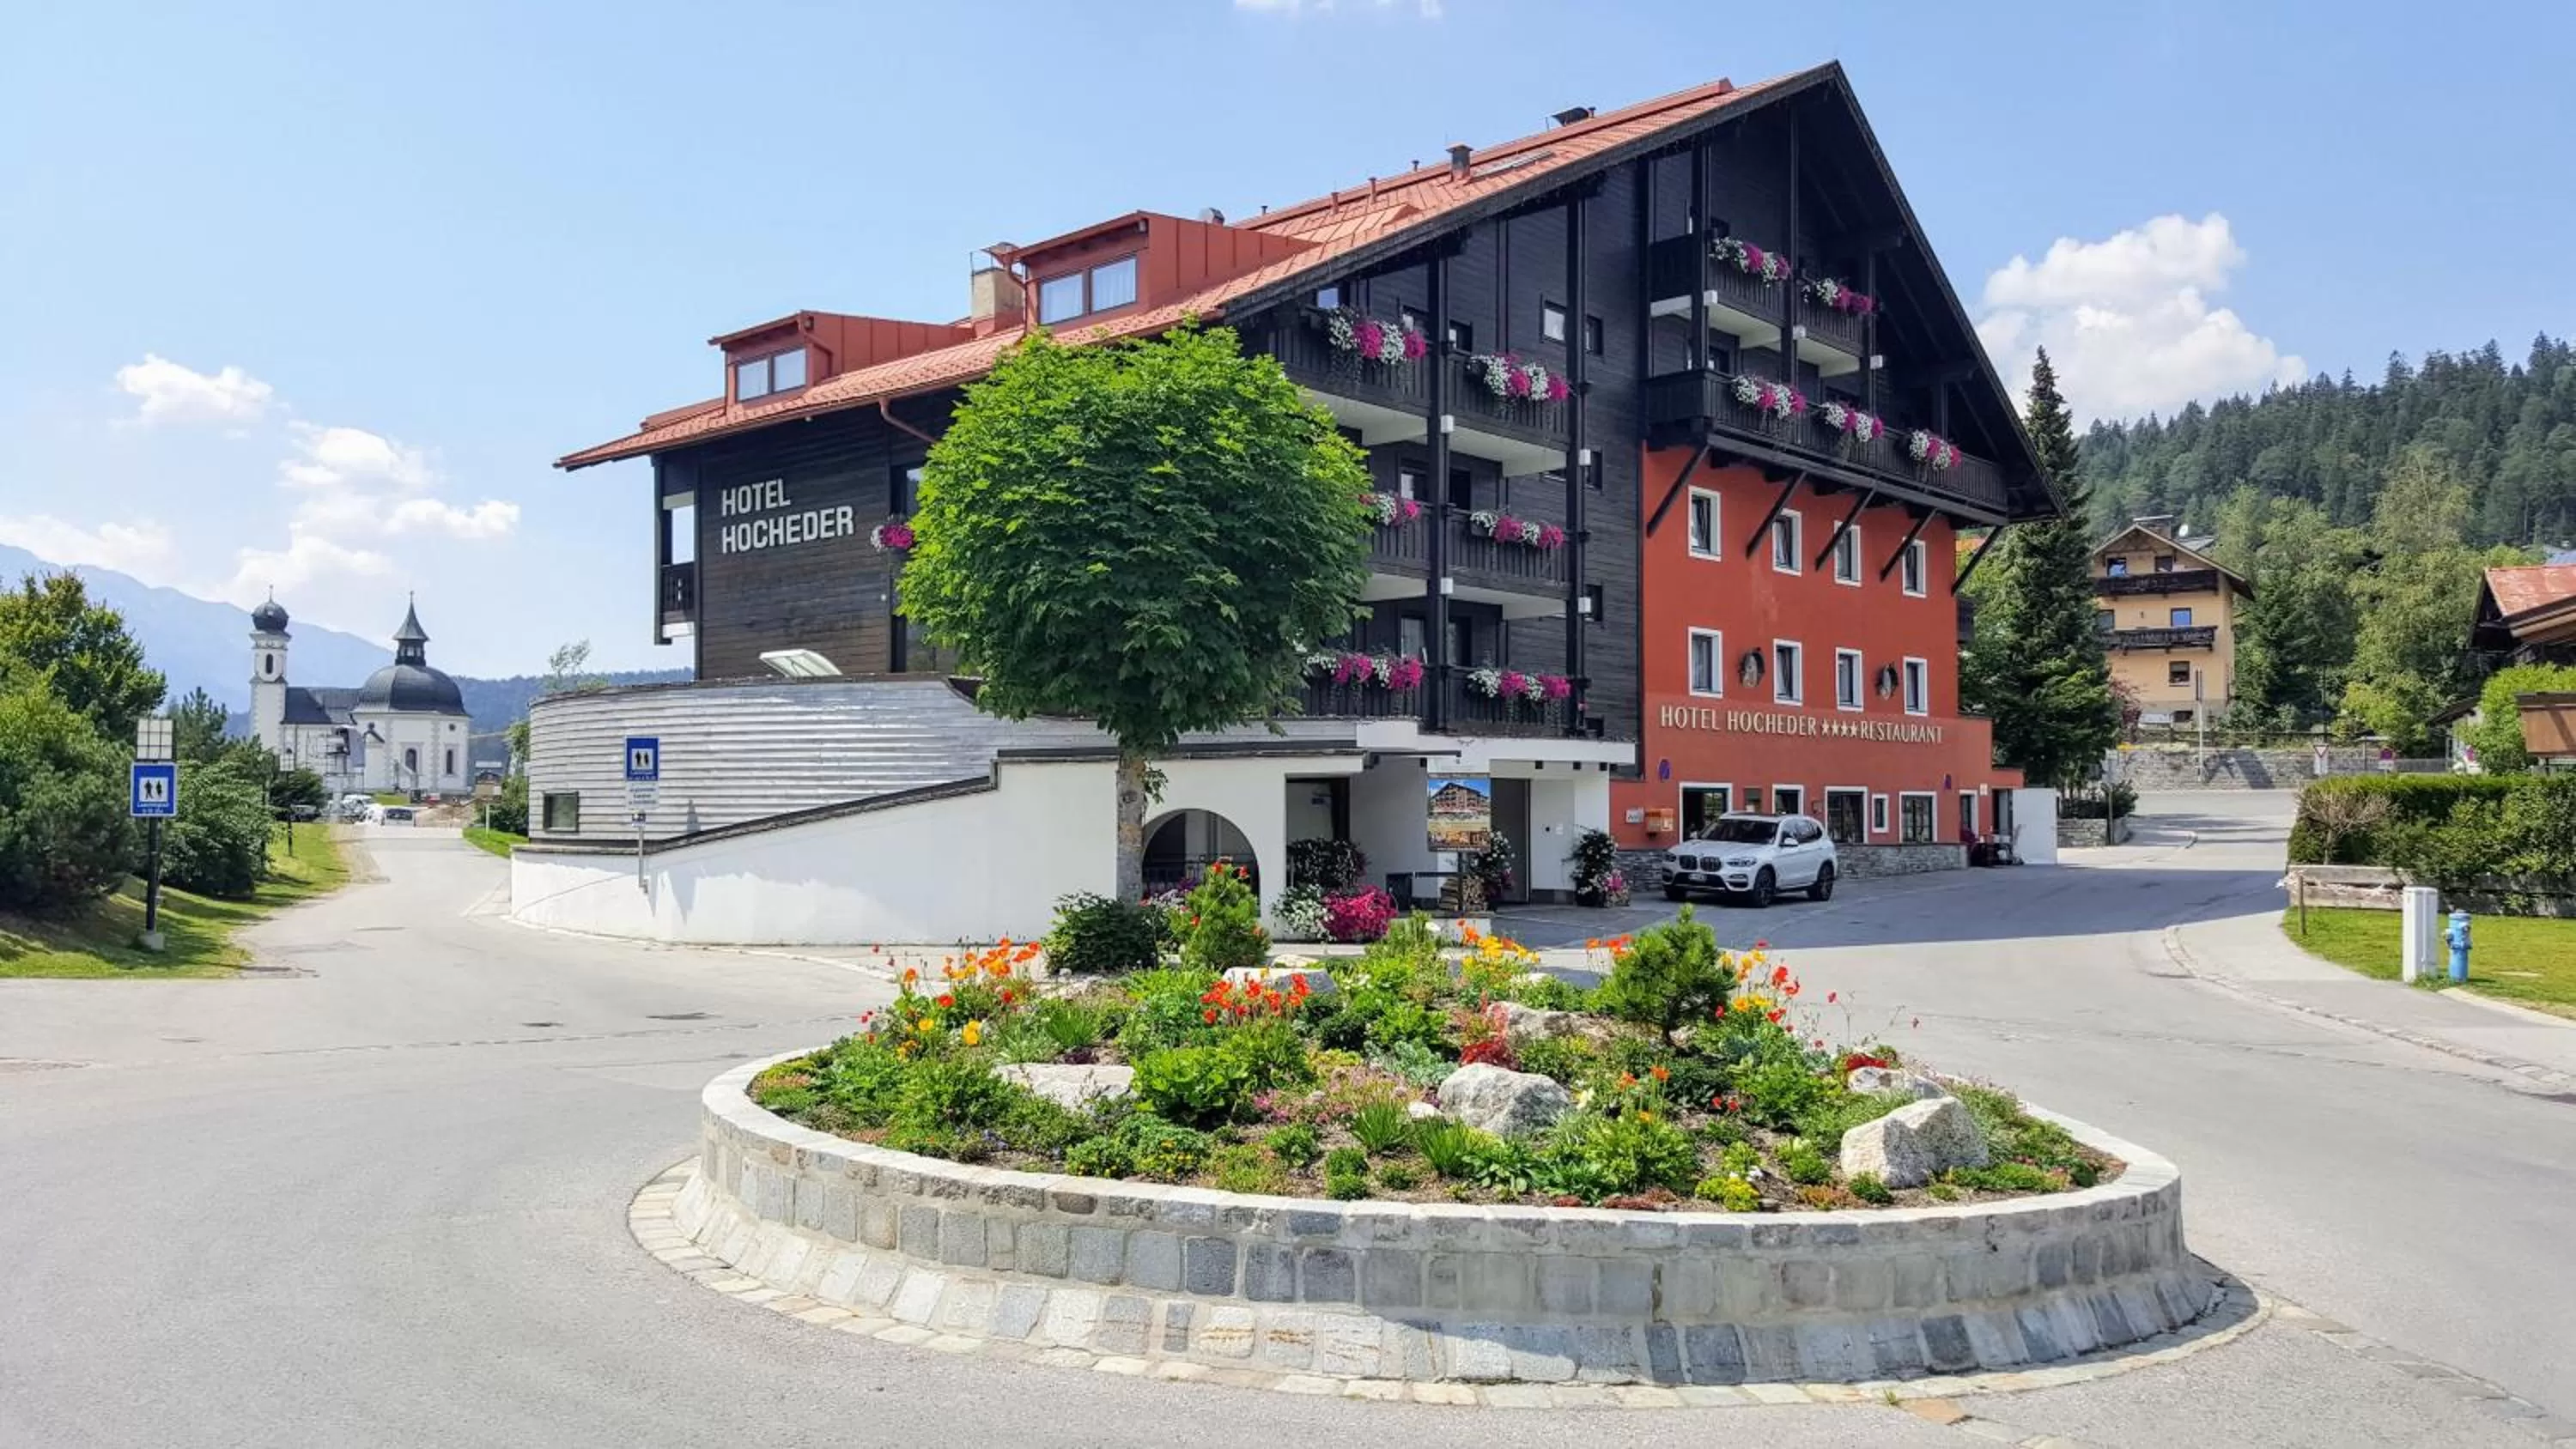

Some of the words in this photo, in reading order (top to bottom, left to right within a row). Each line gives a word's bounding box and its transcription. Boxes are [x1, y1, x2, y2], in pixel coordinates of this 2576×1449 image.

[722, 479, 791, 516] HOTEL
[722, 506, 854, 554] HOCHEDER
[1661, 706, 1720, 731] HOTEL
[1728, 711, 1816, 737] HOCHEDER
[1861, 722, 1943, 744] RESTAURANT
